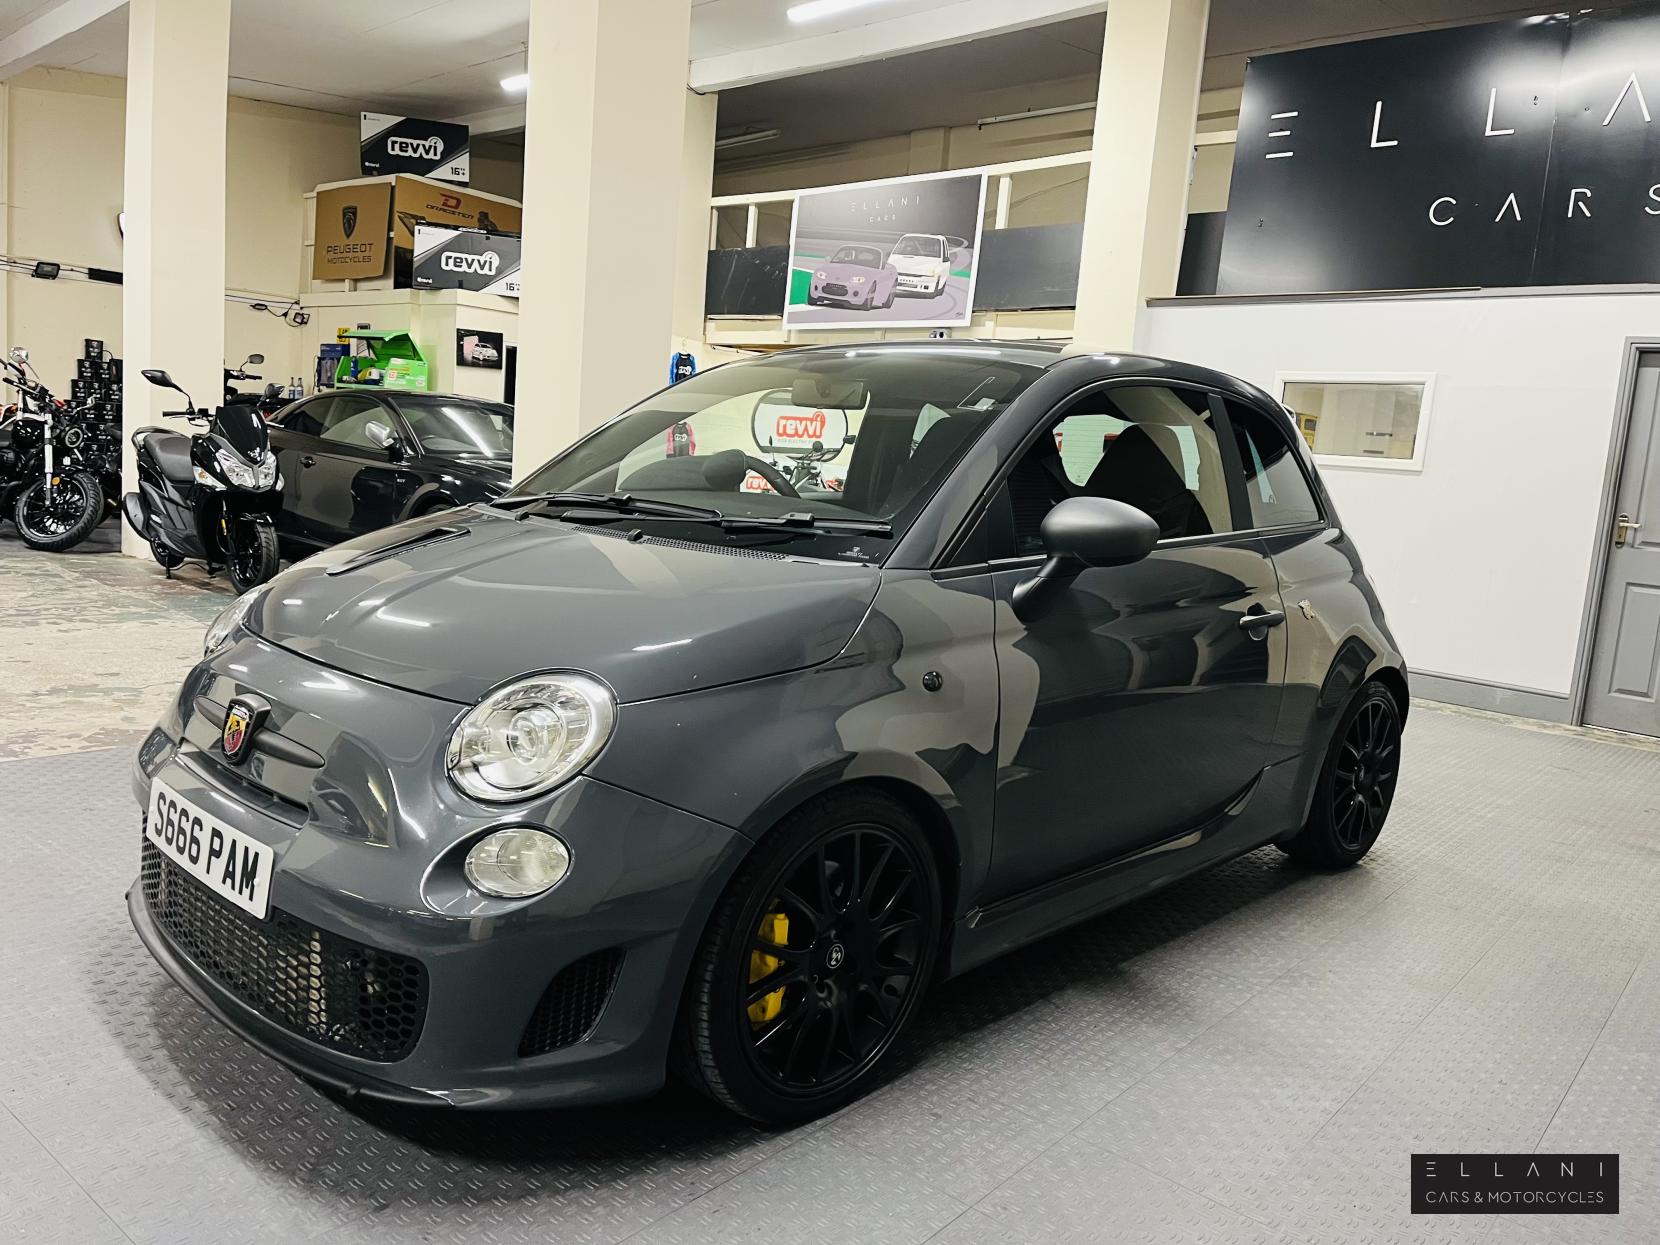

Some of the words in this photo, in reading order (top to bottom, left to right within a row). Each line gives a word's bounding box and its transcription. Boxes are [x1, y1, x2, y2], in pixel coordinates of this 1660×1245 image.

[389, 138, 442, 158] revvi
[426, 204, 474, 220] DRAGSTER
[850, 195, 920, 212] ELLANI
[327, 243, 374, 255] PEUGEOT
[443, 253, 496, 273] revvi
[777, 413, 824, 438] revvi
[154, 791, 203, 866] S666
[205, 826, 260, 902] PAM
